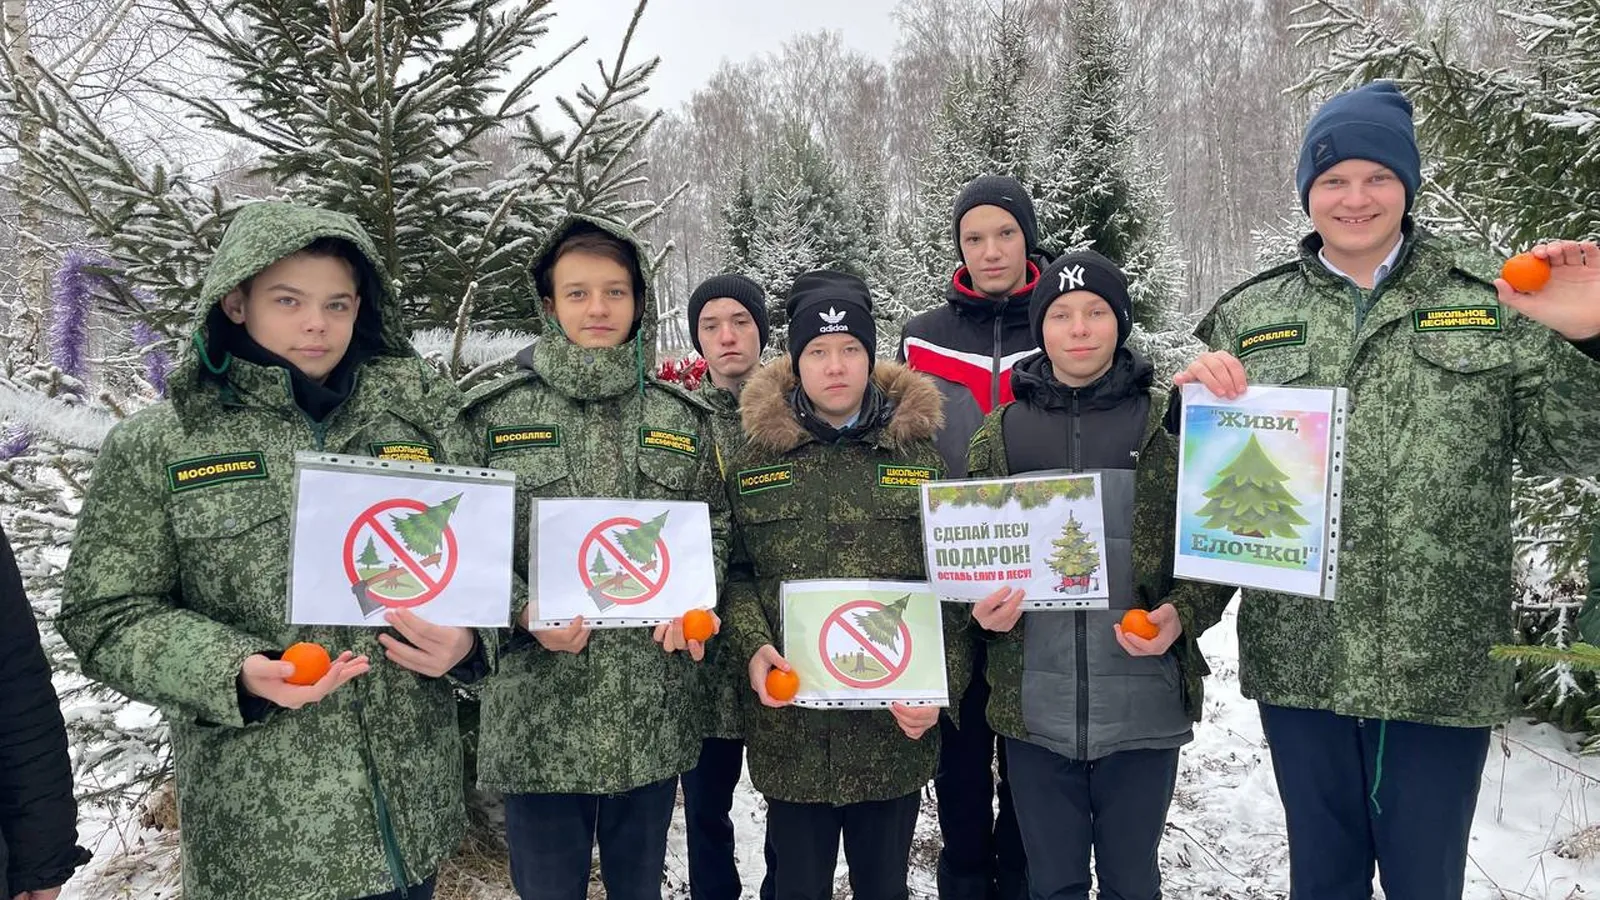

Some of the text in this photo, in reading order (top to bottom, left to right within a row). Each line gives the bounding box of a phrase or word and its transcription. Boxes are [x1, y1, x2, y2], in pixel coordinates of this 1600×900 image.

[1059, 264, 1085, 292] NY
[1428, 309, 1486, 319] ШКОЛЬНОЕ
[820, 324, 849, 333] adidas
[1420, 318, 1496, 327] ЛЕСНИЧЕСТВО
[1242, 329, 1298, 348] МОСОБЛЛЕС
[495, 432, 552, 443] МОСОБЛЛЕС
[651, 431, 691, 444] ШКОЛЬНОЕ
[383, 445, 429, 455] ШКОЛЬНОЕ
[645, 437, 696, 452] ЛЕСНИЧЕСТВО
[177, 461, 257, 481] МОСОБЛЛЕС
[887, 468, 930, 478] ШКОЛЬНОЕ
[741, 470, 791, 487] МОСОБЛЛЕС
[934, 522, 1029, 543] СДЕЛАЙ ЛЕСУ
[935, 544, 1031, 569] ПОДАРОК!
[937, 571, 972, 581] ОСТАВЬ
[998, 570, 1004, 580] В
[1007, 569, 1032, 580] ЛЕСУ!
